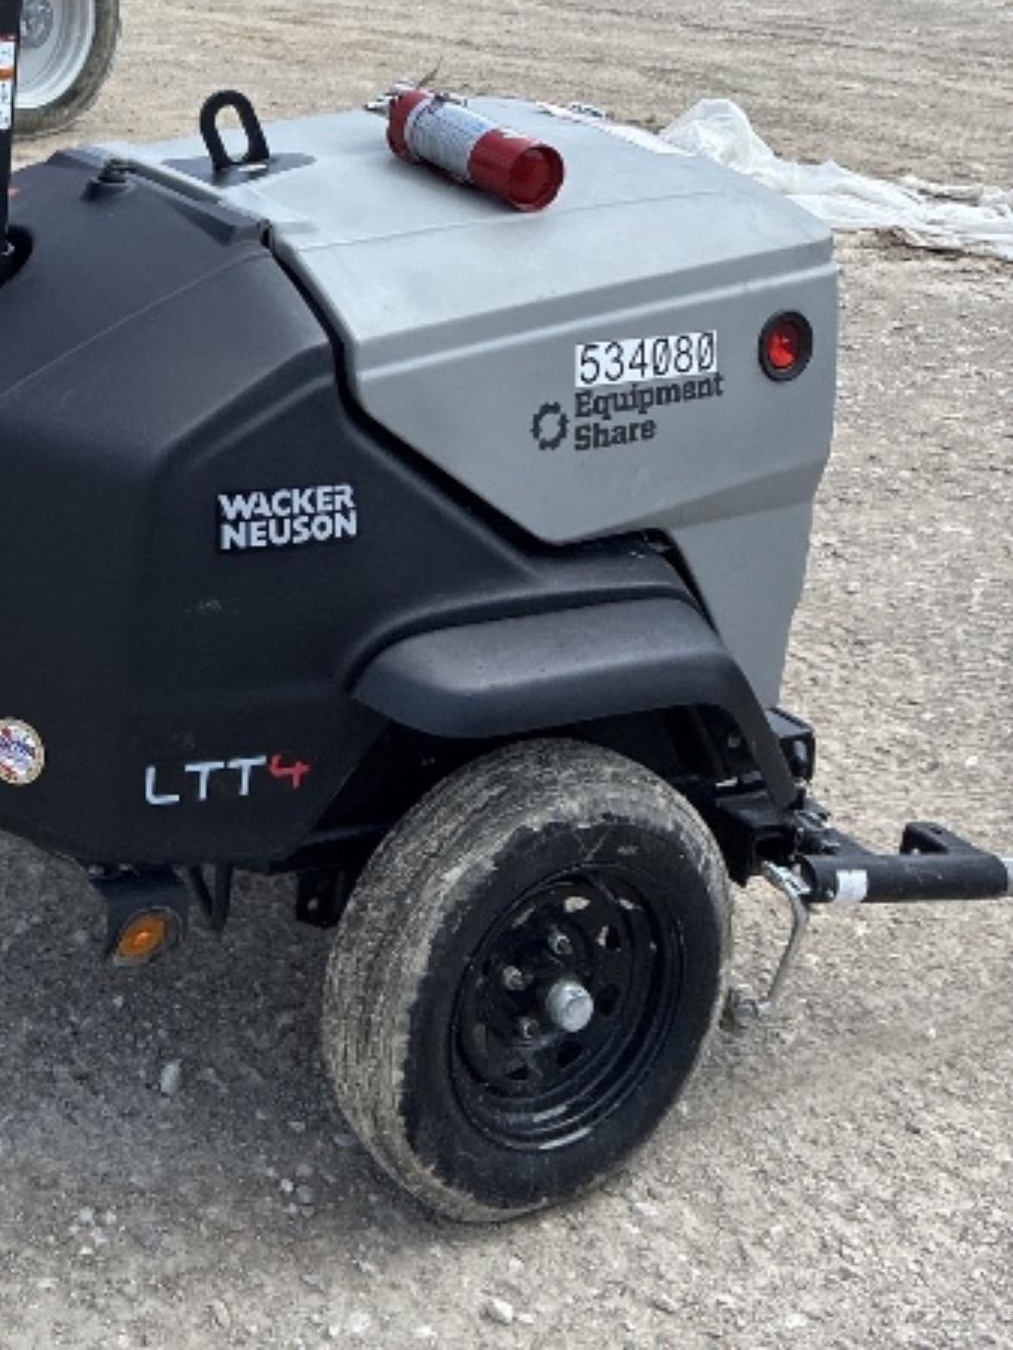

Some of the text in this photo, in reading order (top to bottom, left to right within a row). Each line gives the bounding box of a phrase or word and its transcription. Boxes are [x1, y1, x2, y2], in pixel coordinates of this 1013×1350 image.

[579, 331, 715, 385] 534080
[575, 371, 725, 420] Equipment
[575, 419, 657, 451] Share
[217, 483, 356, 521] WACKER
[219, 509, 358, 551] NEUSON
